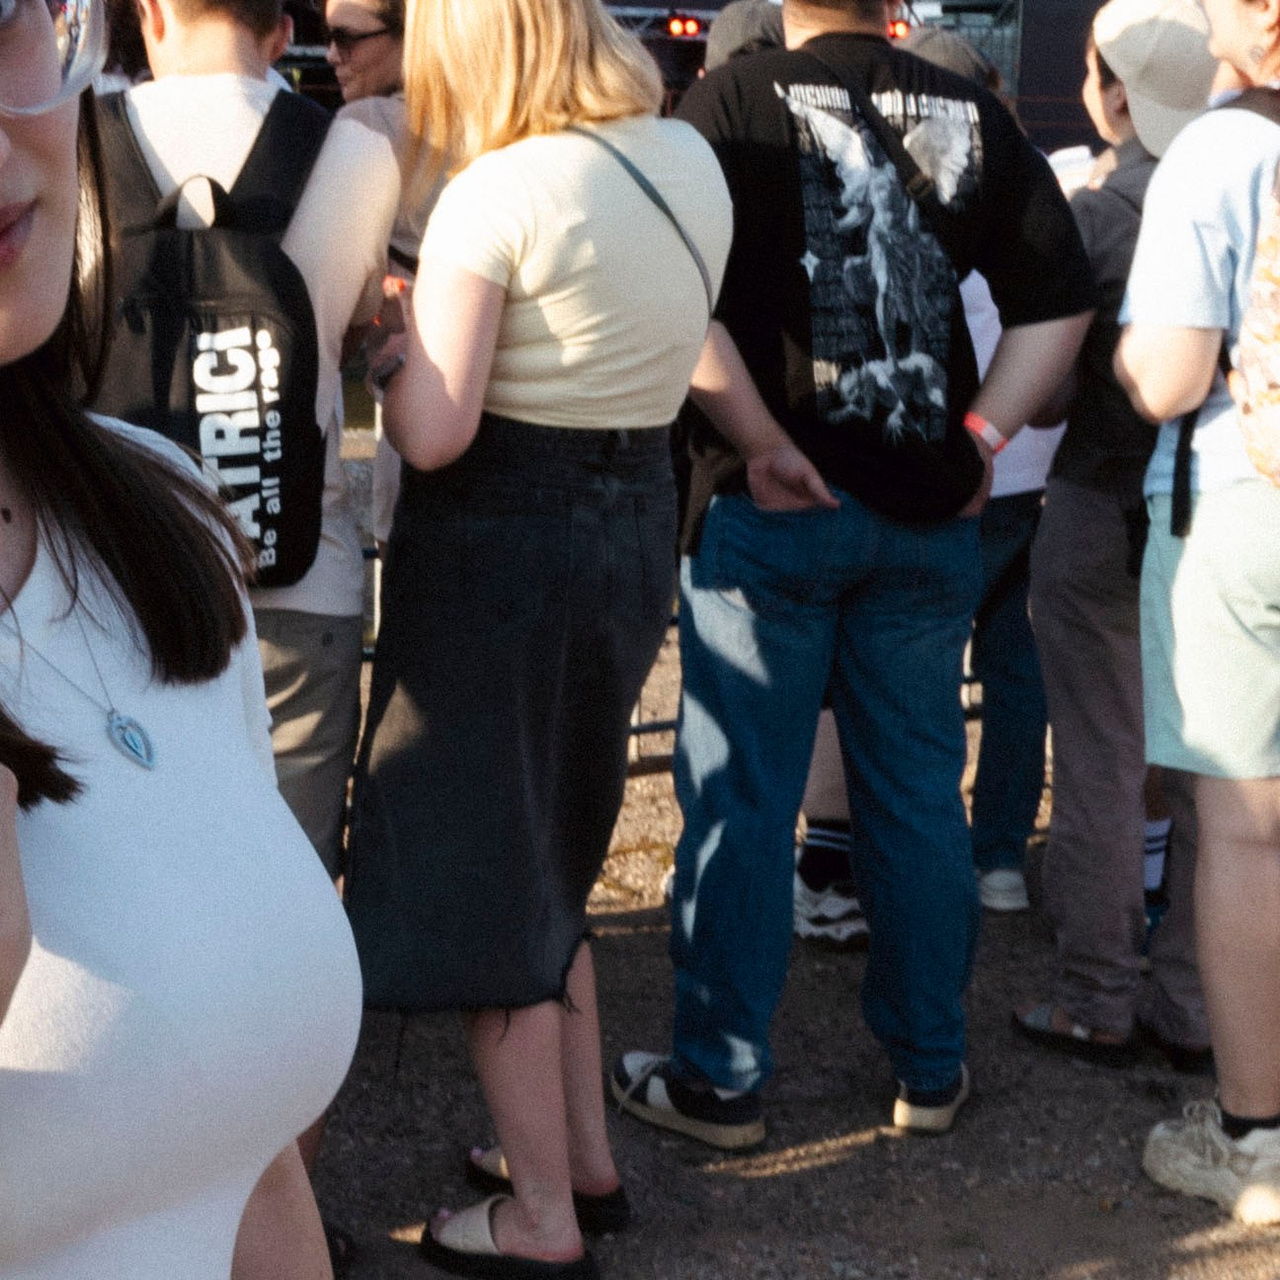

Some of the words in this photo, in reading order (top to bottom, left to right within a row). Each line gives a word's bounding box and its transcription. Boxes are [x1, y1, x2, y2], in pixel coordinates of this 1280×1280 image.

[261, 409, 282, 463] the
[261, 477, 281, 515] all
[257, 528, 278, 570] Be
